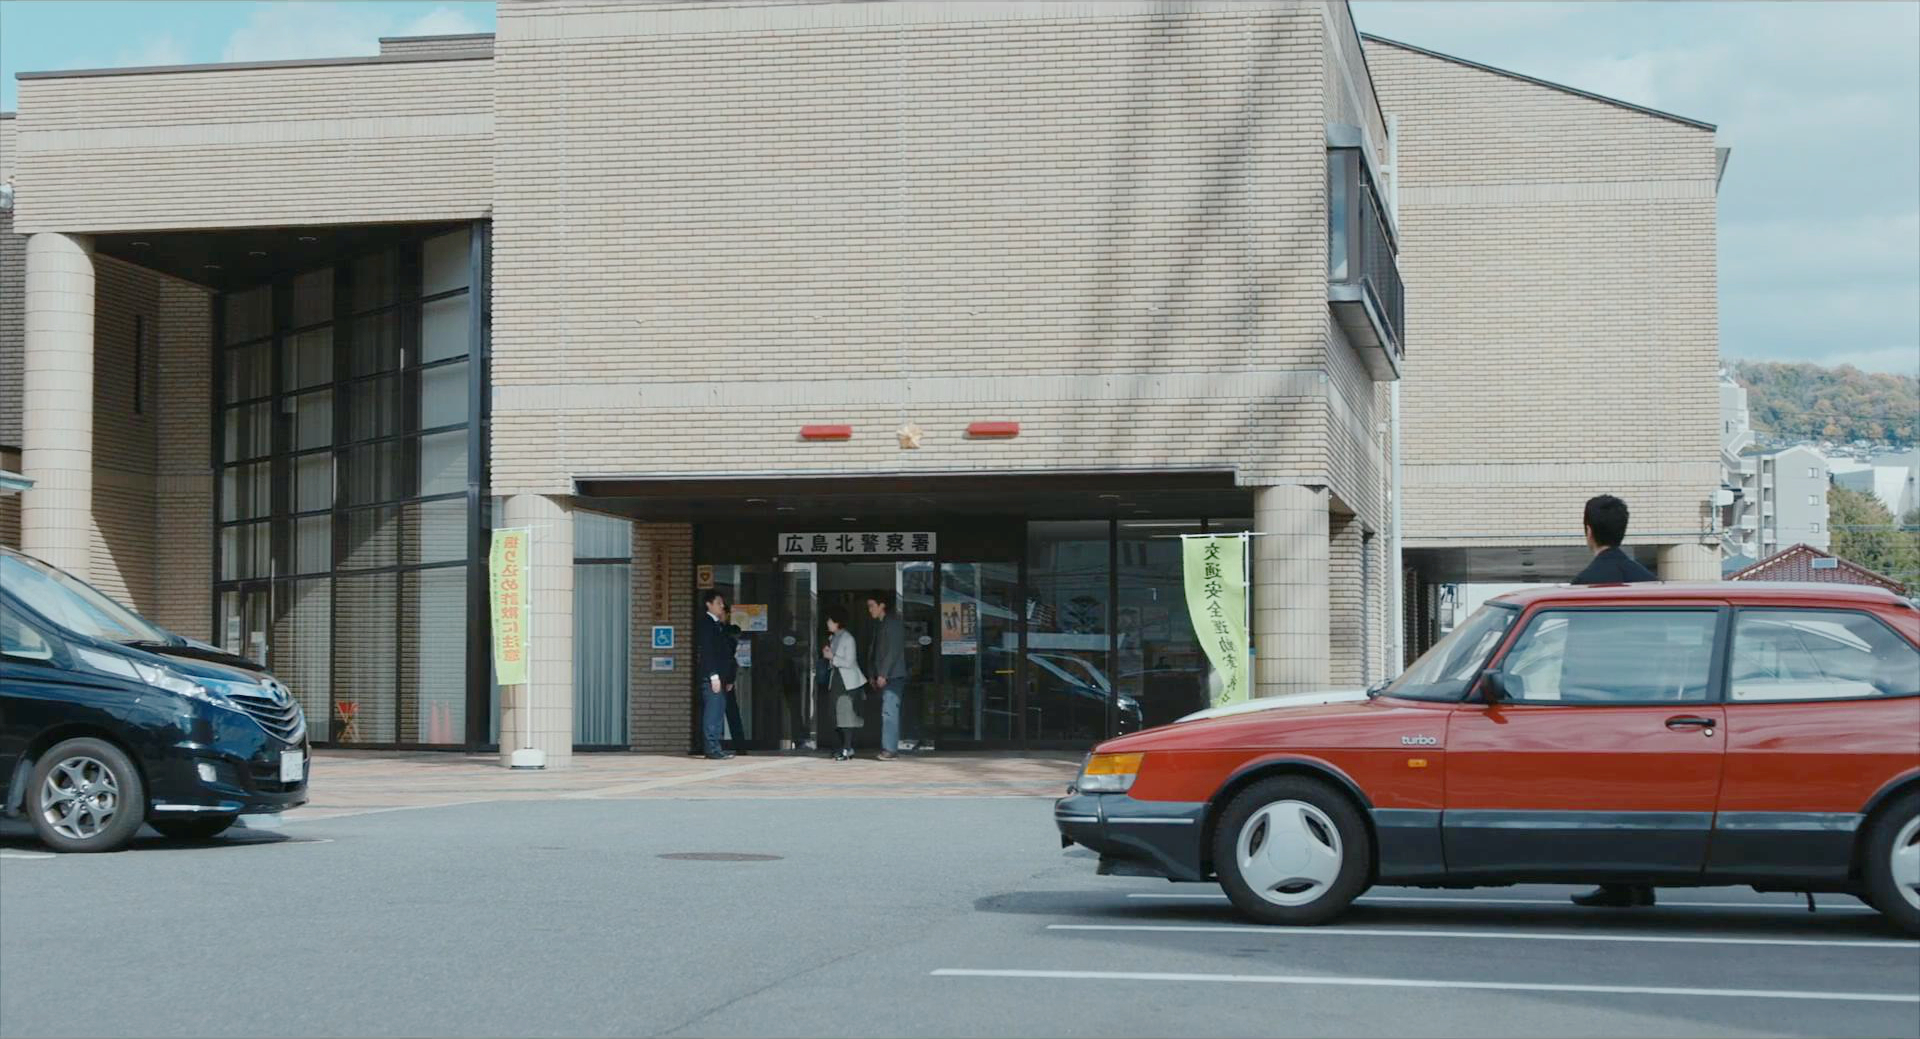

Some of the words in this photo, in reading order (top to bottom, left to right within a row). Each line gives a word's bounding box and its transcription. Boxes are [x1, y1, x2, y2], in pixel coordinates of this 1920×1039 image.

[785, 534, 930, 553] 広島北警察署
[1401, 734, 1437, 745] turbo
